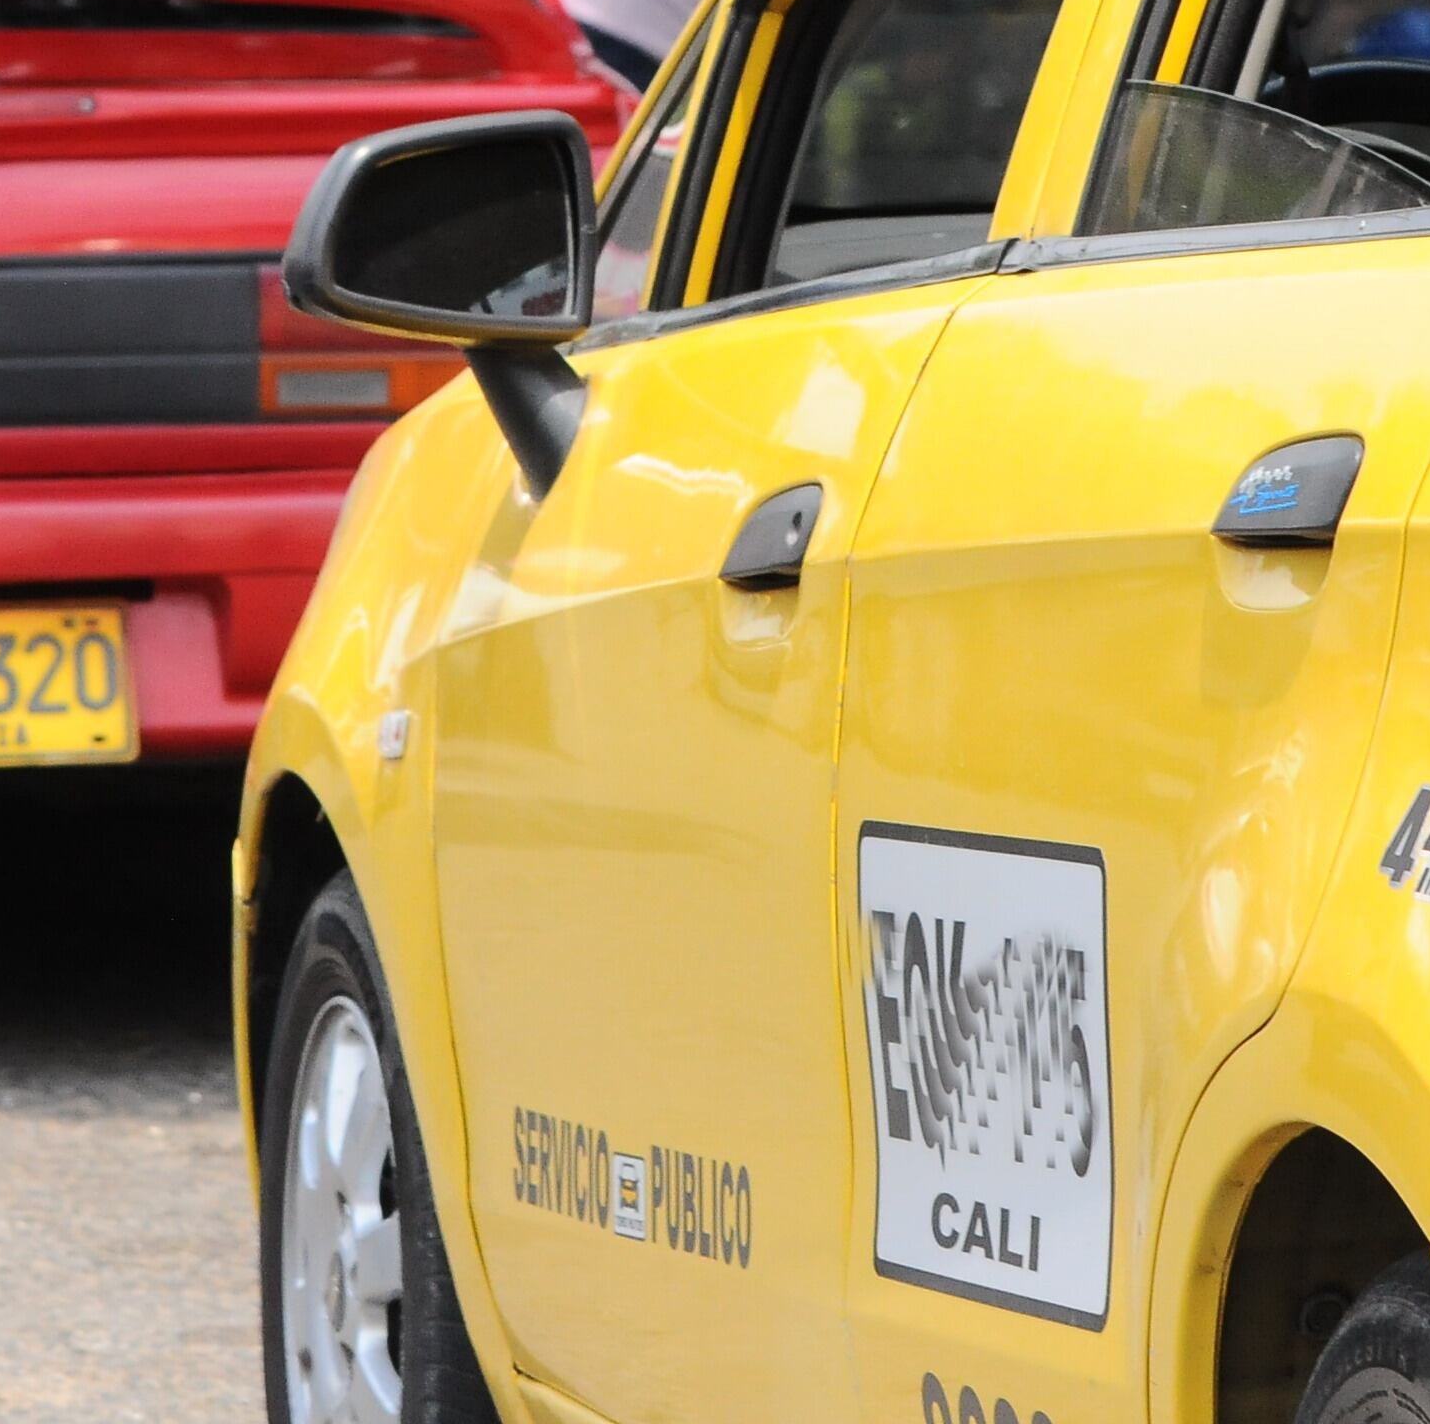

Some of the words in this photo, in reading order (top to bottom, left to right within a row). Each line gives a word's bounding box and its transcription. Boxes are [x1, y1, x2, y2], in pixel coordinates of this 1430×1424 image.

[513, 1104, 610, 1230] SERVICIO
[650, 1143, 752, 1270] PUBLICO
[930, 1192, 1041, 1273] CALI
